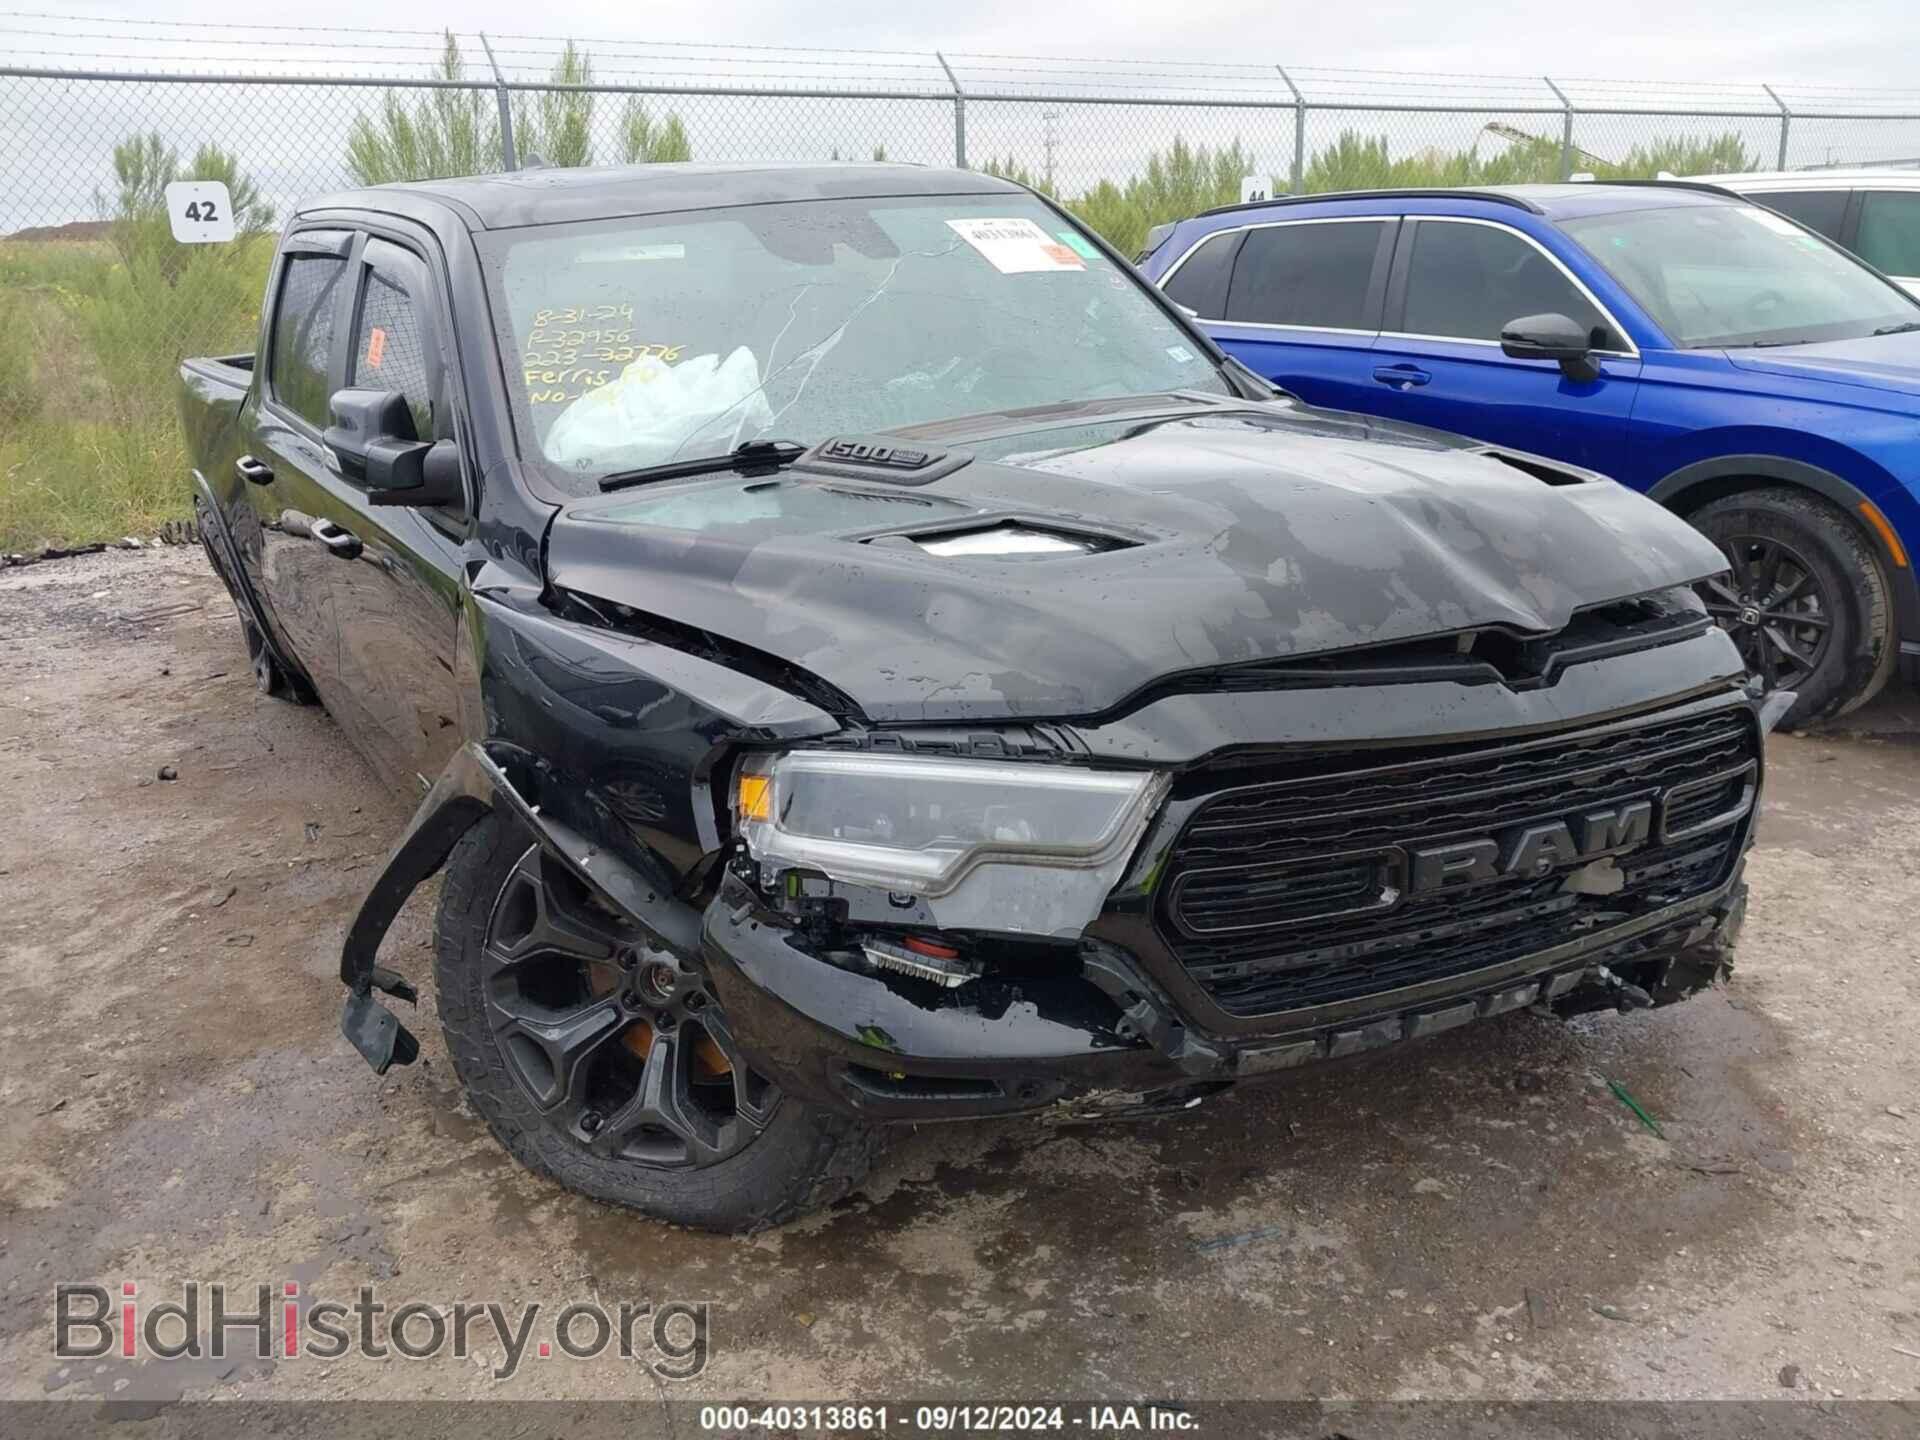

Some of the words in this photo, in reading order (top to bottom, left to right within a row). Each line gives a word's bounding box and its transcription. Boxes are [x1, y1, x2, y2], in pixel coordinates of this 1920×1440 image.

[185, 201, 218, 222] 42
[534, 304, 634, 327] 8-31-24
[825, 440, 894, 461] 1500
[1414, 800, 1652, 890] RAM
